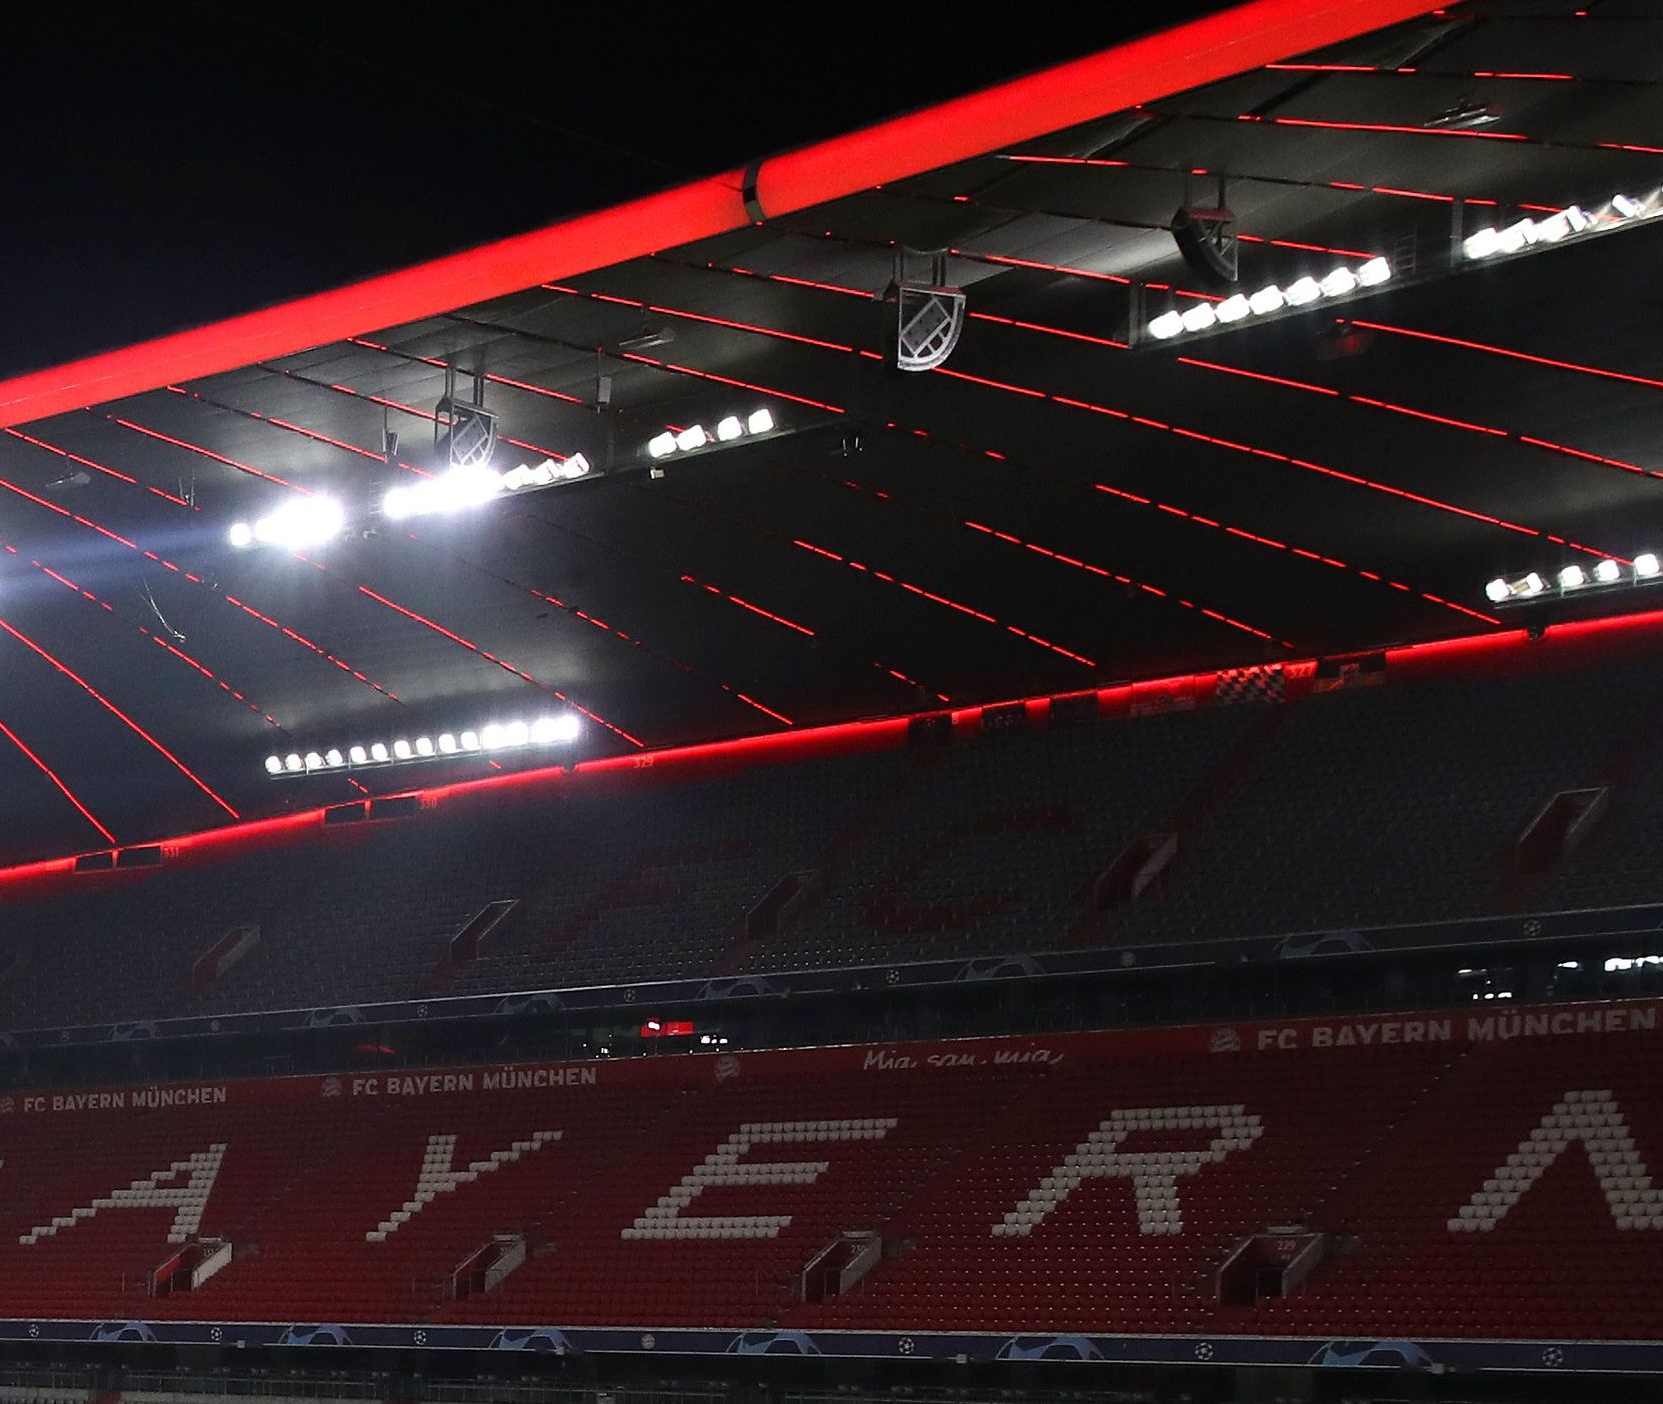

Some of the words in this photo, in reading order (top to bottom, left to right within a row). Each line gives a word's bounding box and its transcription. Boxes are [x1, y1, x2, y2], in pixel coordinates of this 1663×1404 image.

[1258, 1028, 1298, 1051] FC
[1311, 1019, 1452, 1048] BAYERN
[1467, 1007, 1656, 1042] MÜNCHEN
[351, 1079, 378, 1096] FC
[386, 1074, 474, 1095] BAYERN
[482, 1066, 597, 1089] MÜNCHEN
[24, 1098, 47, 1114] FC
[52, 1094, 125, 1111] BAYERN
[132, 1086, 227, 1109] MÜNCHEN
